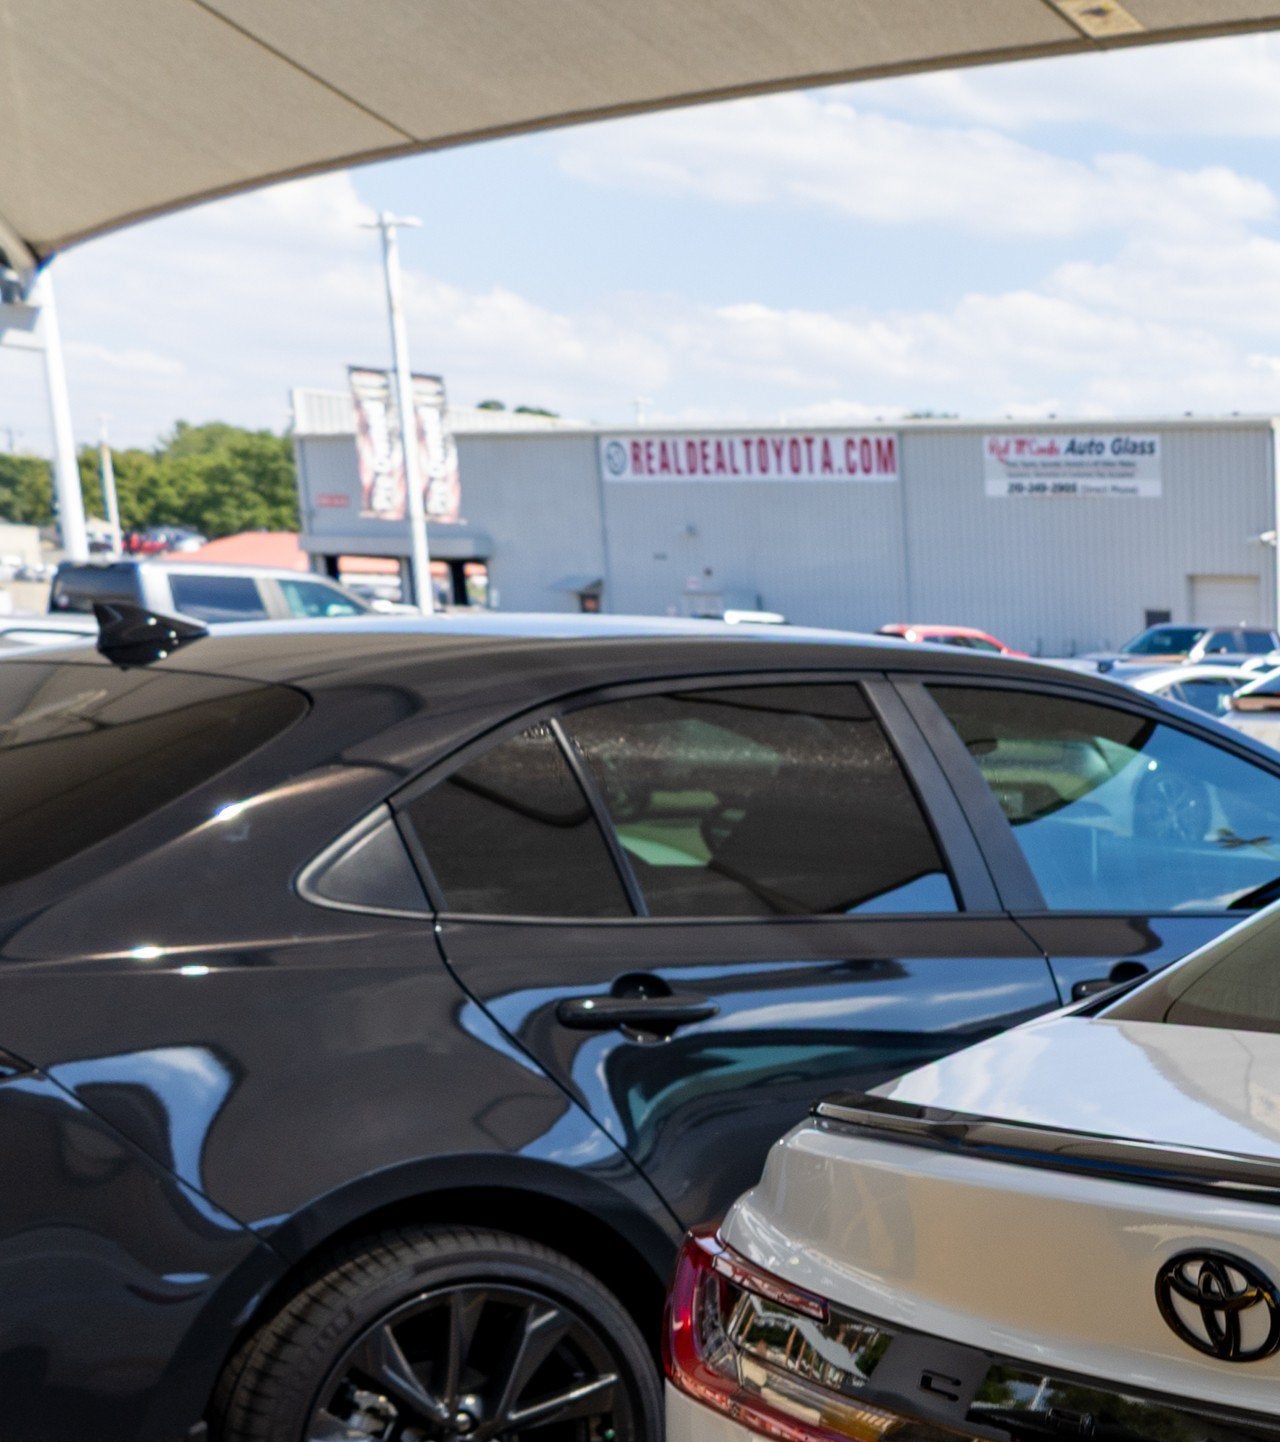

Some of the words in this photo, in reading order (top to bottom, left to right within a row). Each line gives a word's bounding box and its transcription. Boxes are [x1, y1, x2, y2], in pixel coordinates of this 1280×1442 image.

[630, 436, 896, 475] REALDEALTOYOTA.COM
[1065, 438, 1106, 455] Auto
[1111, 436, 1156, 456] Glass
